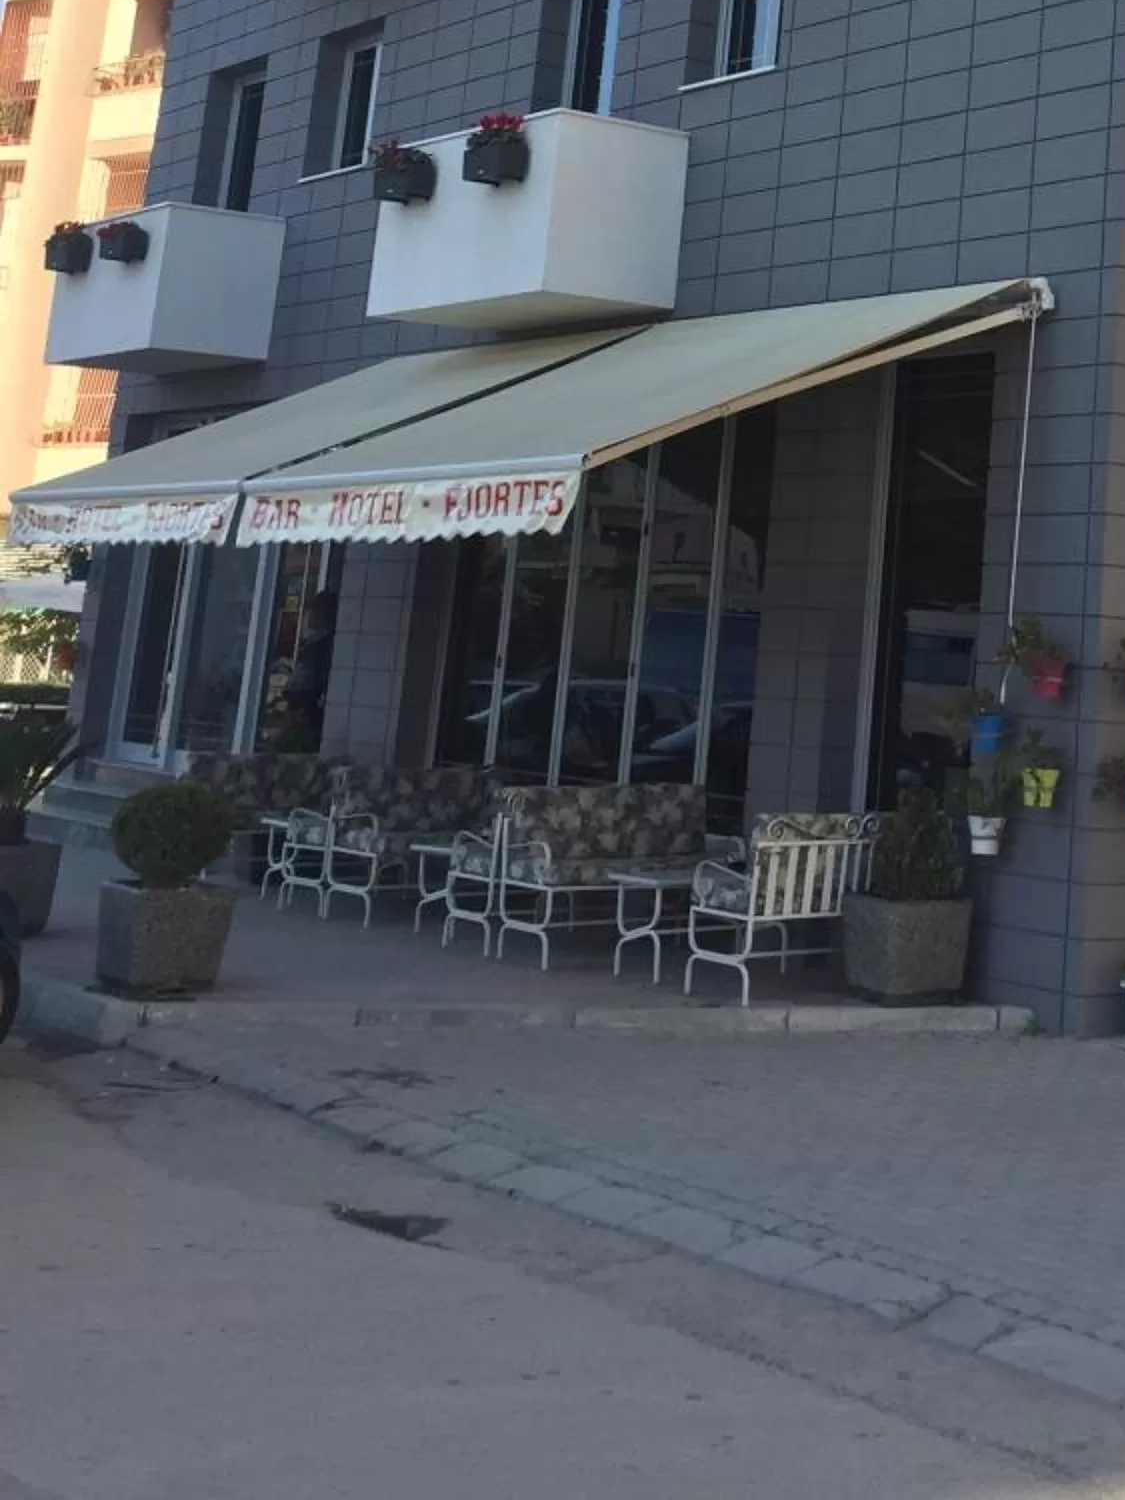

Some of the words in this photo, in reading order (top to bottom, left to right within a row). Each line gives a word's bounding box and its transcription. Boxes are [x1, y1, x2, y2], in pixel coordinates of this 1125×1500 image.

[250, 495, 300, 528] BAR
[329, 490, 405, 526] HOTEL
[444, 480, 565, 521] FJORTES
